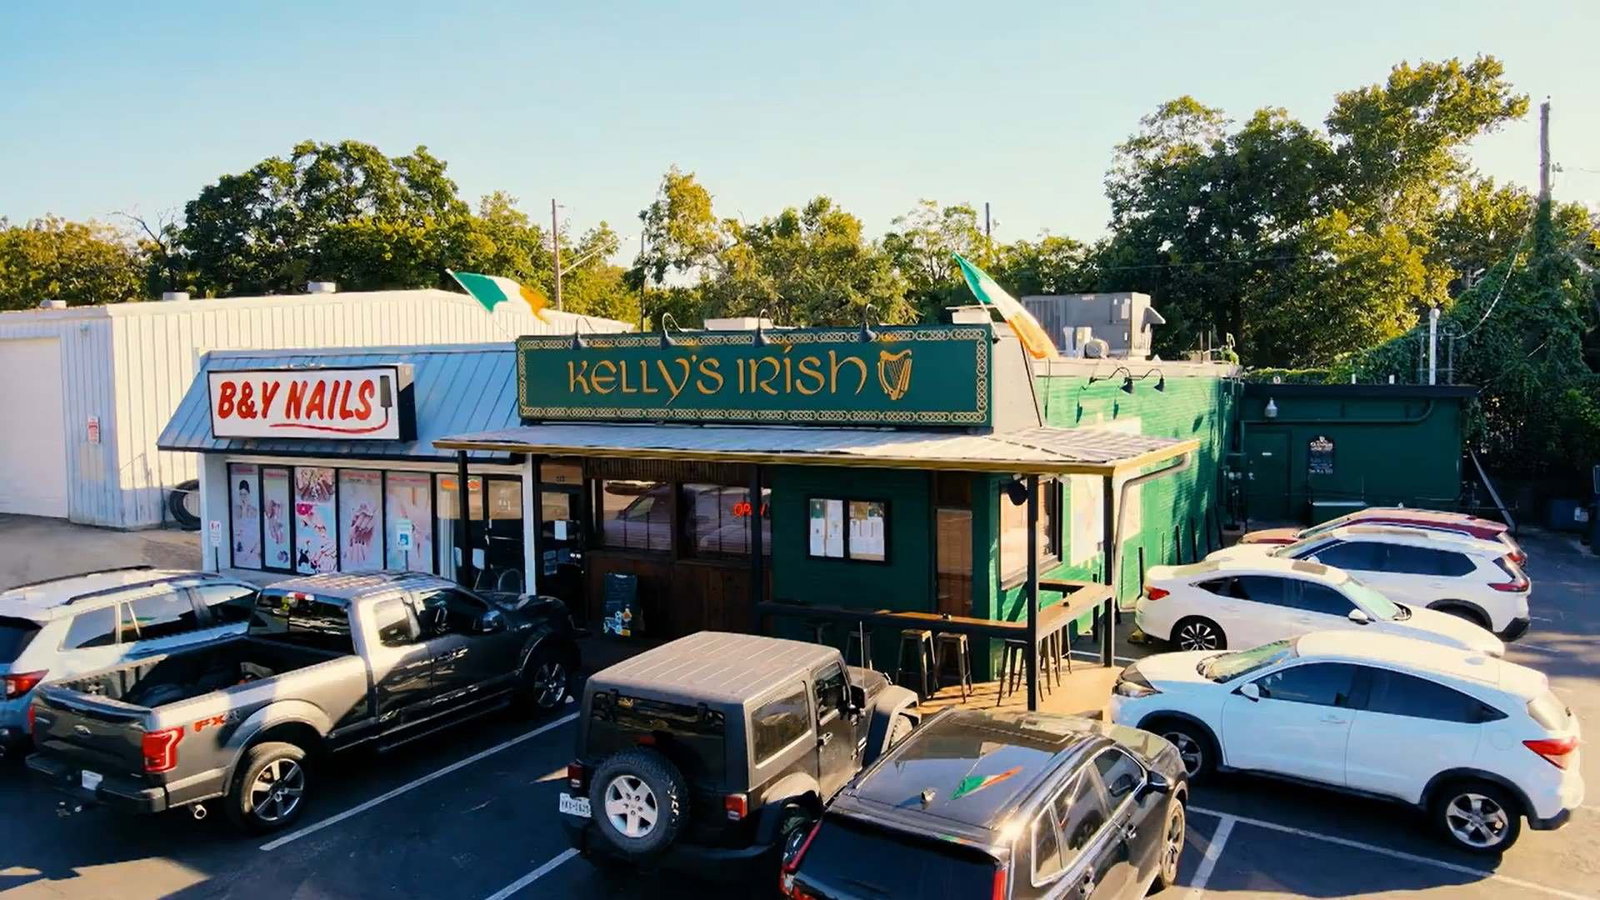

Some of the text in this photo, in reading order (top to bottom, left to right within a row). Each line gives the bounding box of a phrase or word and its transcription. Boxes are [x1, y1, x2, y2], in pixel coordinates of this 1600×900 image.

[217, 379, 376, 421] B&Y NAILS
[567, 345, 868, 407] KELLY'S IRISH
